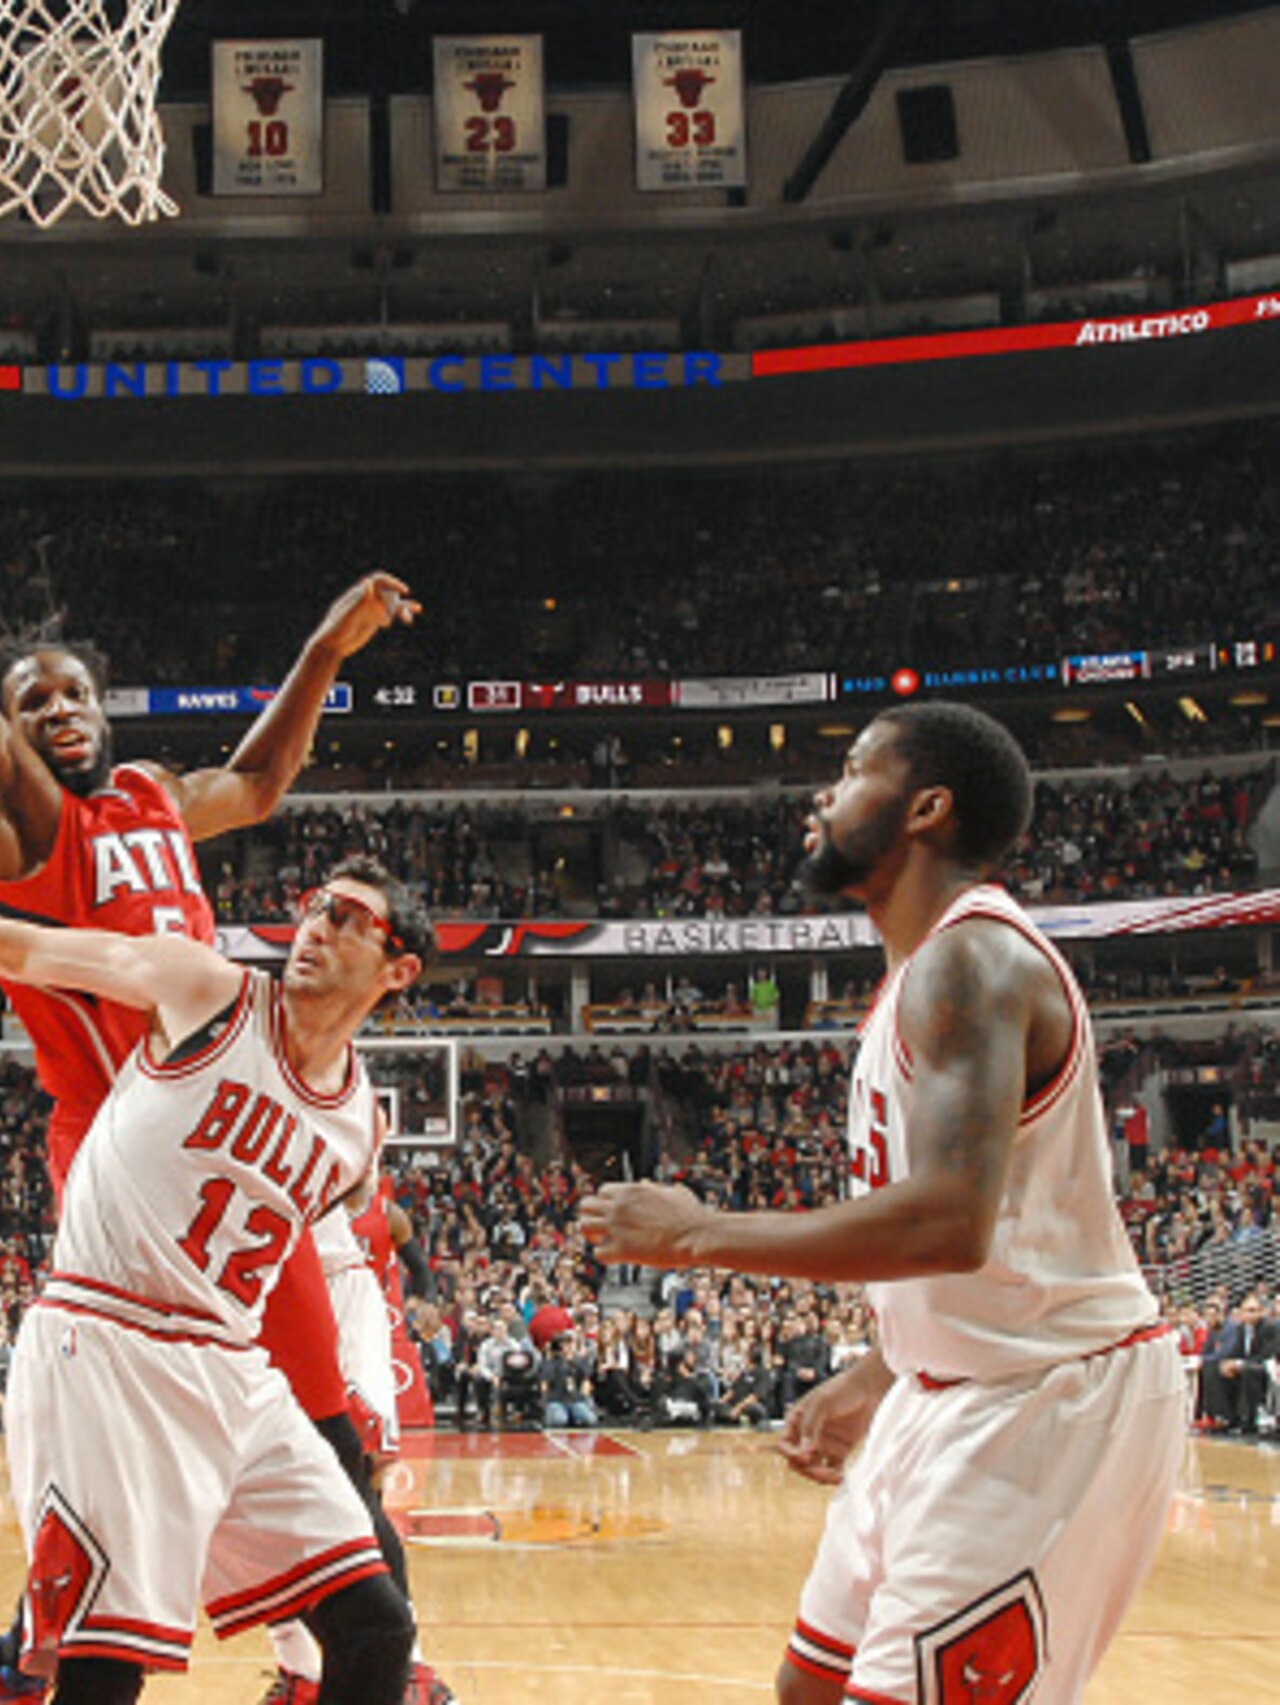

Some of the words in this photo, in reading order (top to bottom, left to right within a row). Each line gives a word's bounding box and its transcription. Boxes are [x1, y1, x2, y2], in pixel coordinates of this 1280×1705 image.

[247, 120, 287, 156] 10
[464, 116, 516, 152] 23
[666, 112, 714, 147] 33
[1075, 310, 1209, 346] ATHLETICO
[46, 357, 343, 399] UNITED
[426, 351, 723, 392] CENTER
[177, 691, 237, 708] HAWKS
[575, 684, 642, 704] BULLS
[91, 827, 202, 910] ATL
[176, 1175, 293, 1309] 12
